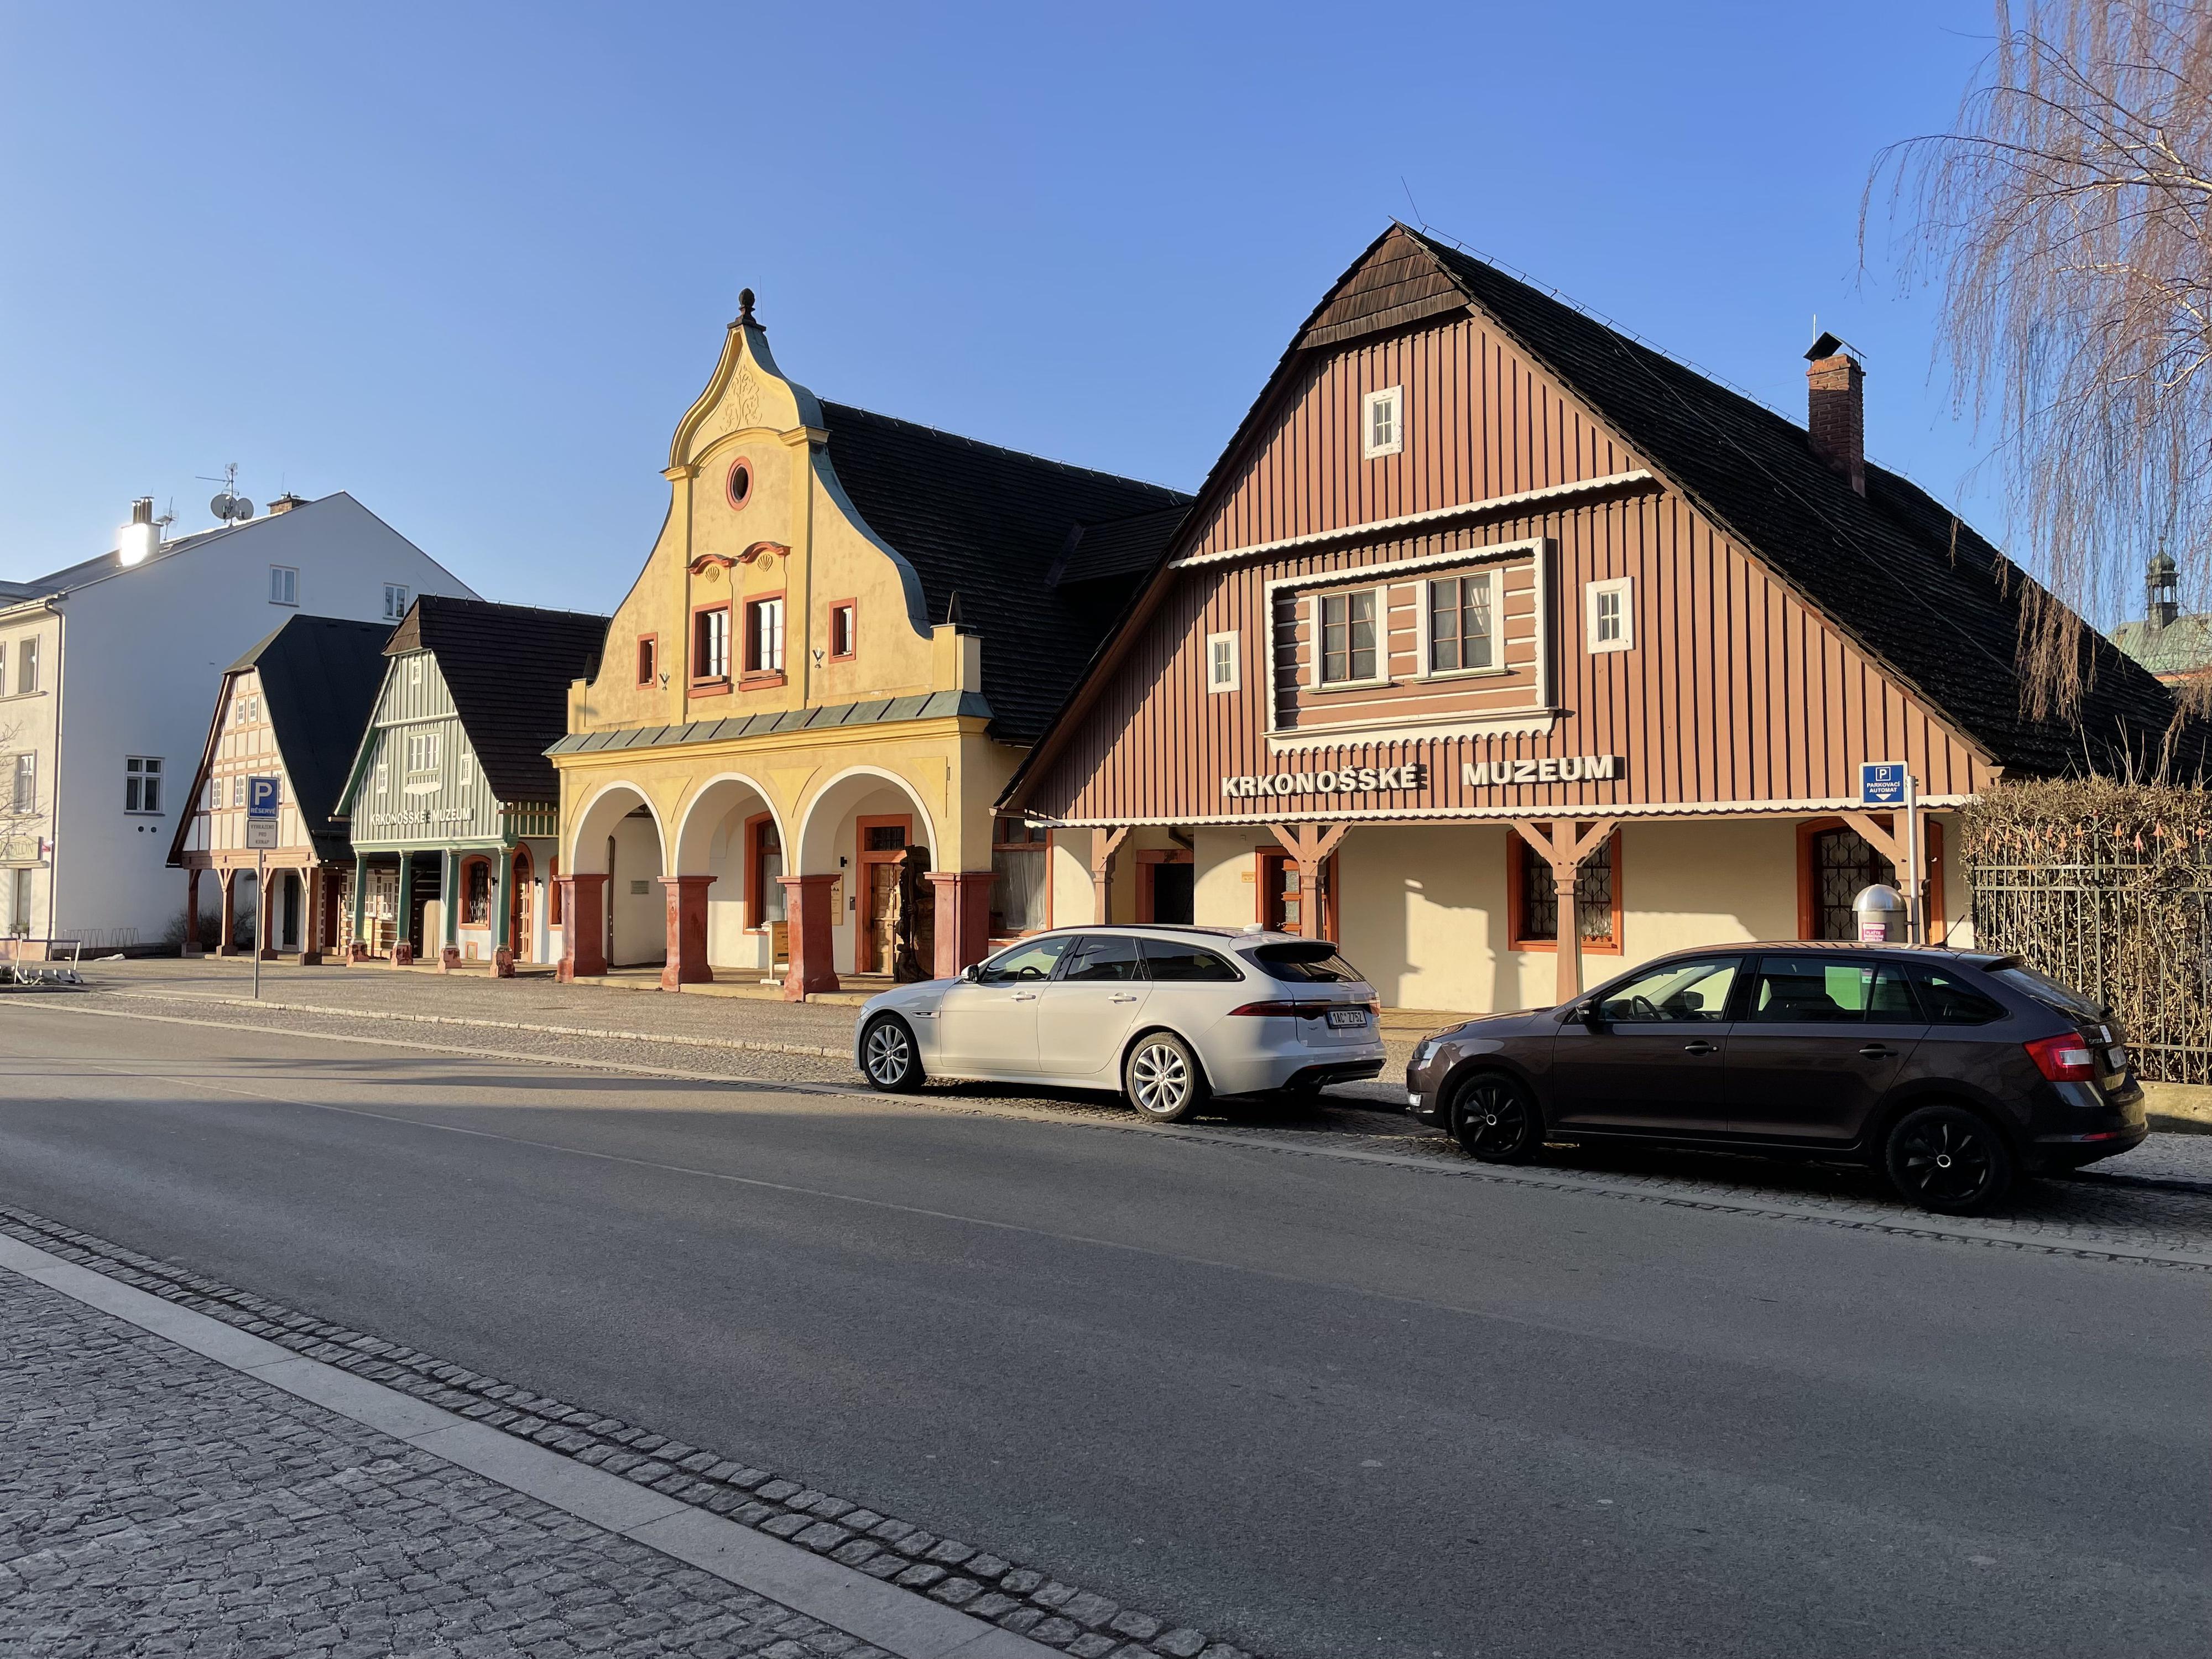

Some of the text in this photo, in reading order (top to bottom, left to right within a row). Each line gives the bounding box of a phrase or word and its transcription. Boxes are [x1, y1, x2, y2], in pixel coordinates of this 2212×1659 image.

[1222, 754, 1614, 797] KRKONOŠSKÉ MUZEUM
[1879, 769, 1887, 779] P
[255, 781, 273, 806] P
[370, 807, 471, 826] KRKONOŠSKÉ MUZEUM
[1333, 1013, 1344, 1023] 1AC
